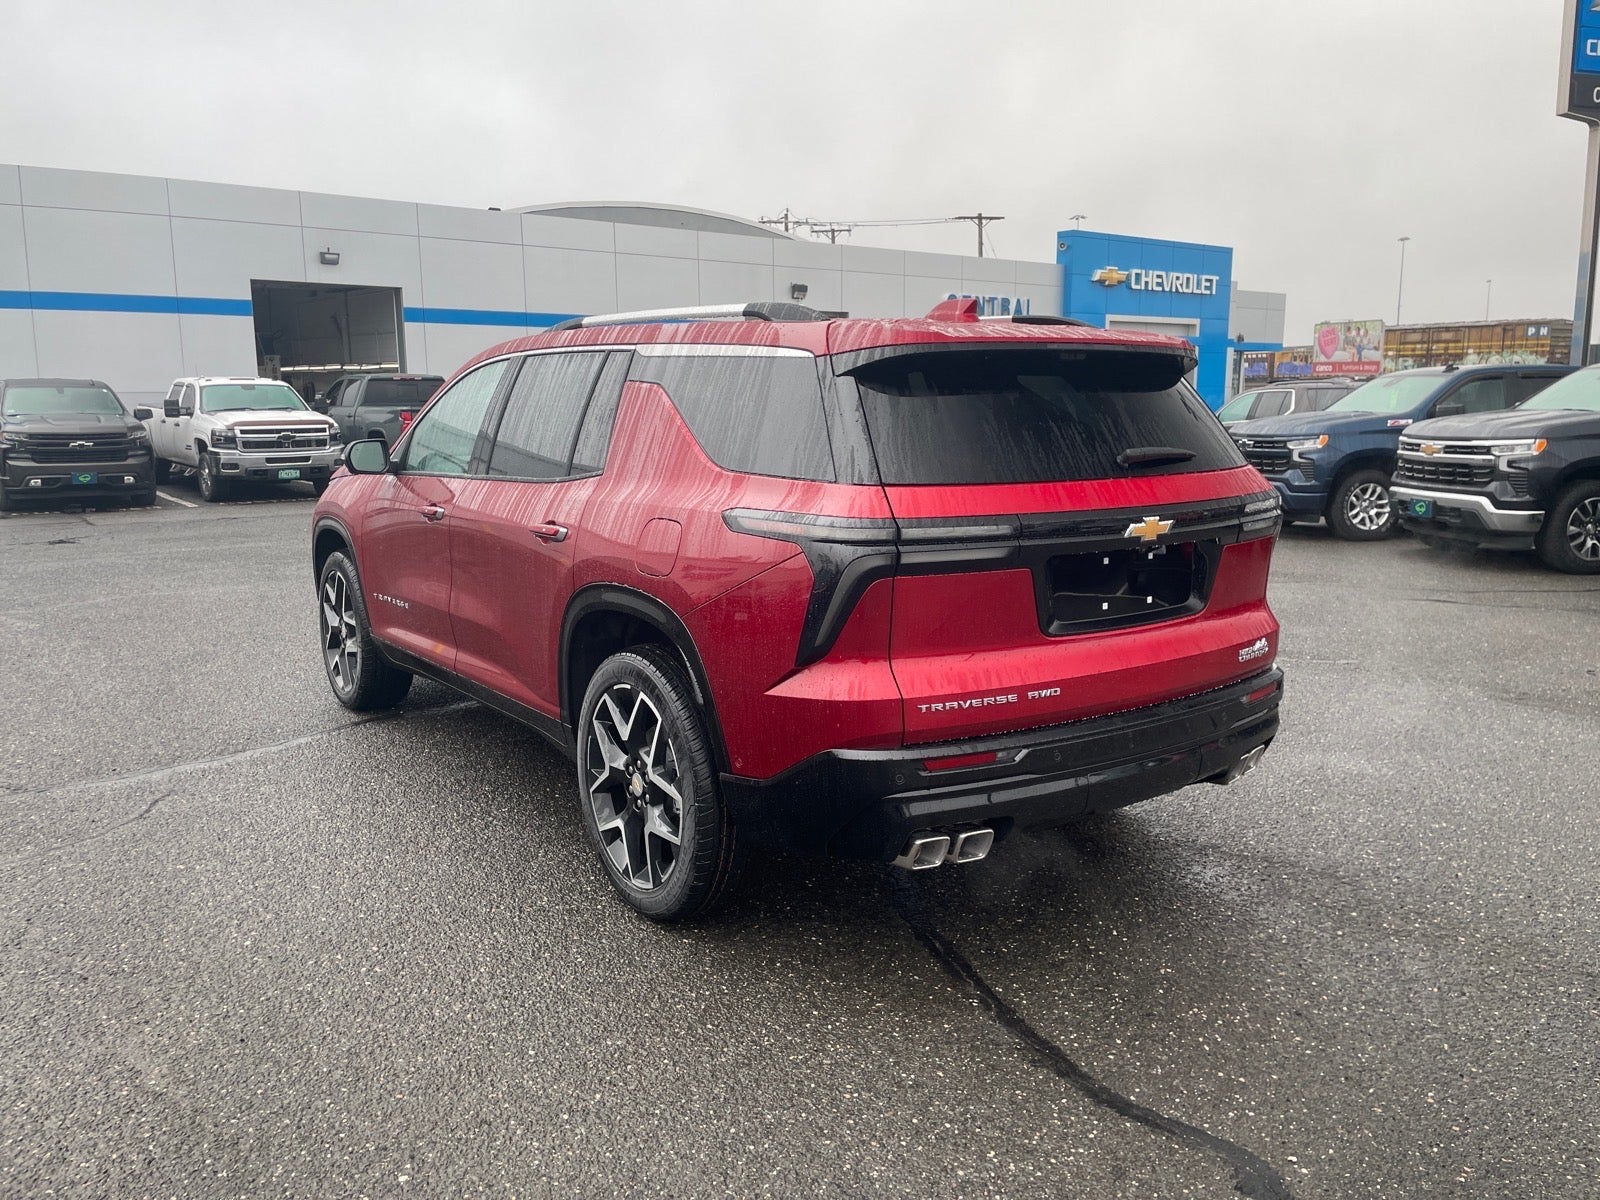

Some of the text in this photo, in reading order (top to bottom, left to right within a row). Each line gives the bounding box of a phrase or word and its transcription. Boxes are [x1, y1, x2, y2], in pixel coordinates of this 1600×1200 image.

[1131, 269, 1219, 295] CHEVROLET
[947, 294, 1030, 316] NTRAL
[917, 687, 1061, 713] TRAVERSE AWD
